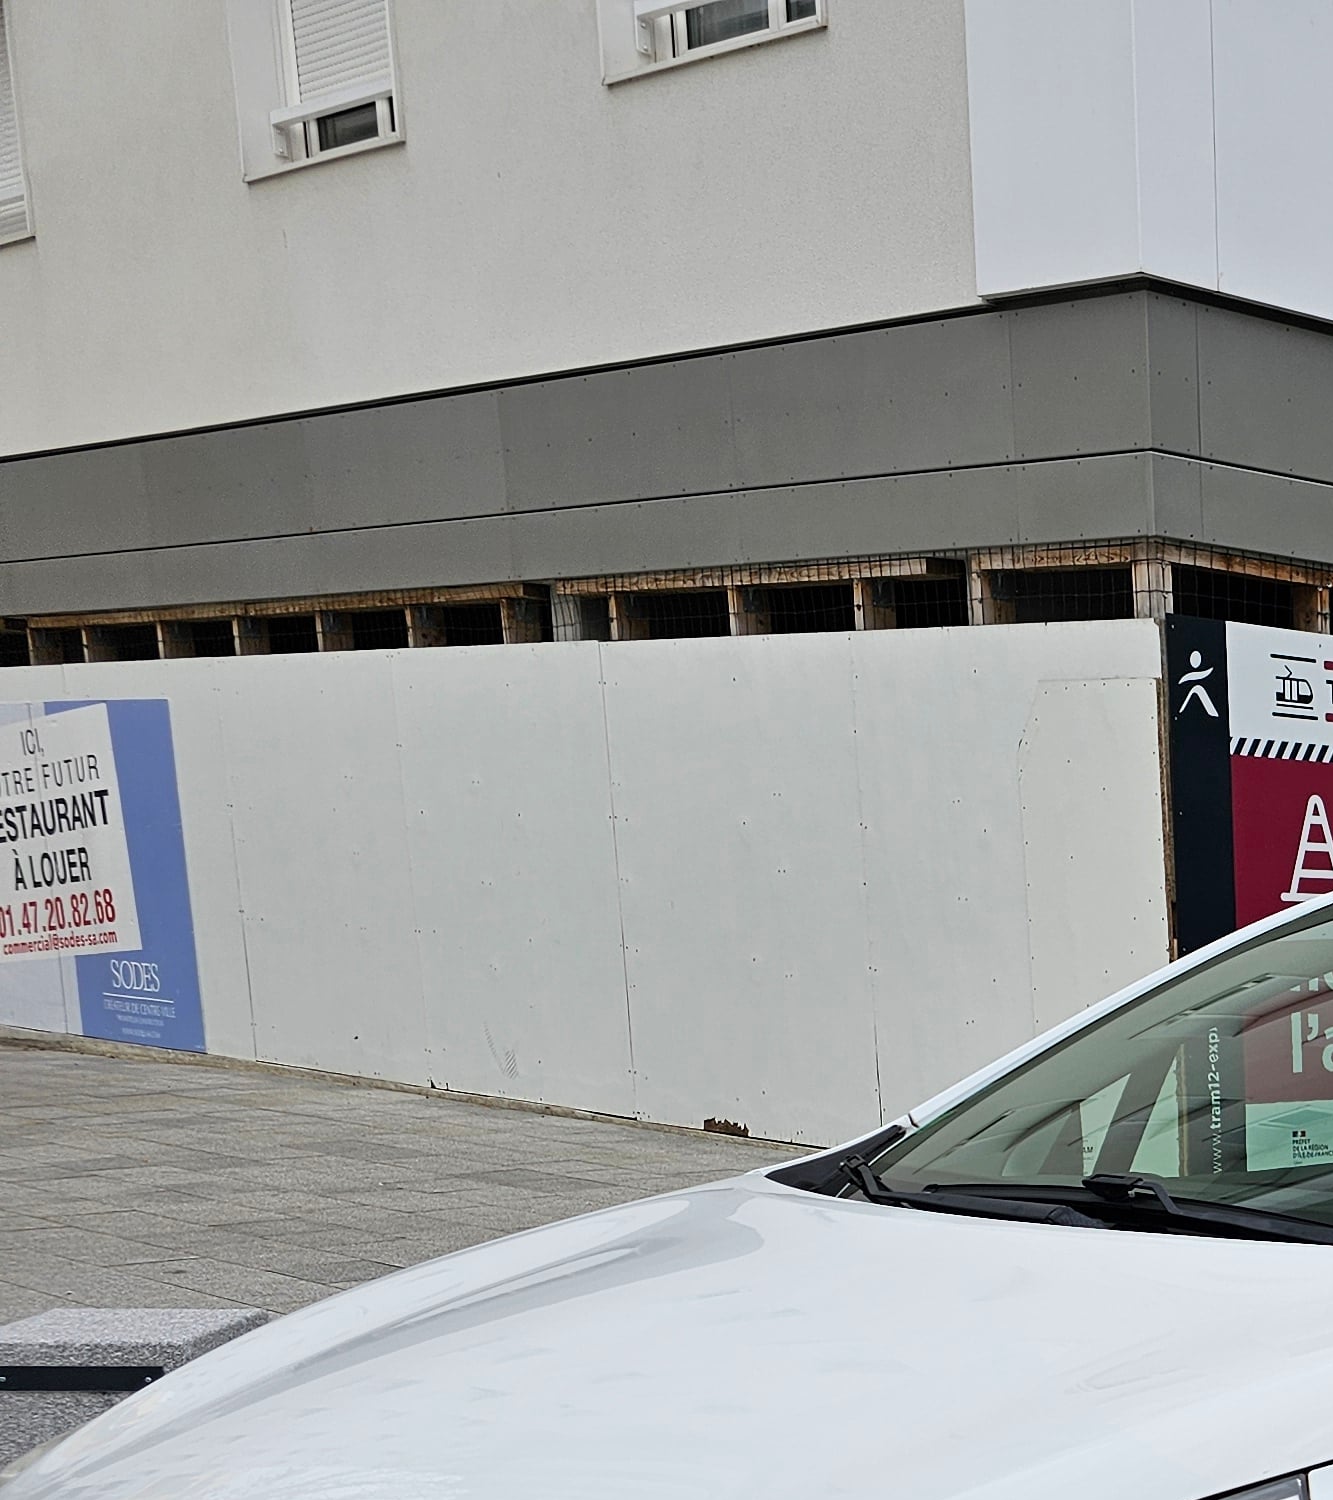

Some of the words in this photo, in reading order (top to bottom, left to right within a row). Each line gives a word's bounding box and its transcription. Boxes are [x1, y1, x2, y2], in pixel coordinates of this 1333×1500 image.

[20, 728, 44, 757] ICI,
[0, 768, 35, 797] TRE
[41, 754, 100, 790] FUTUR
[12, 848, 28, 891] À
[28, 846, 92, 888] LOUER
[0, 888, 116, 938] 01.47.20.82.68
[110, 959, 160, 993] SODES
